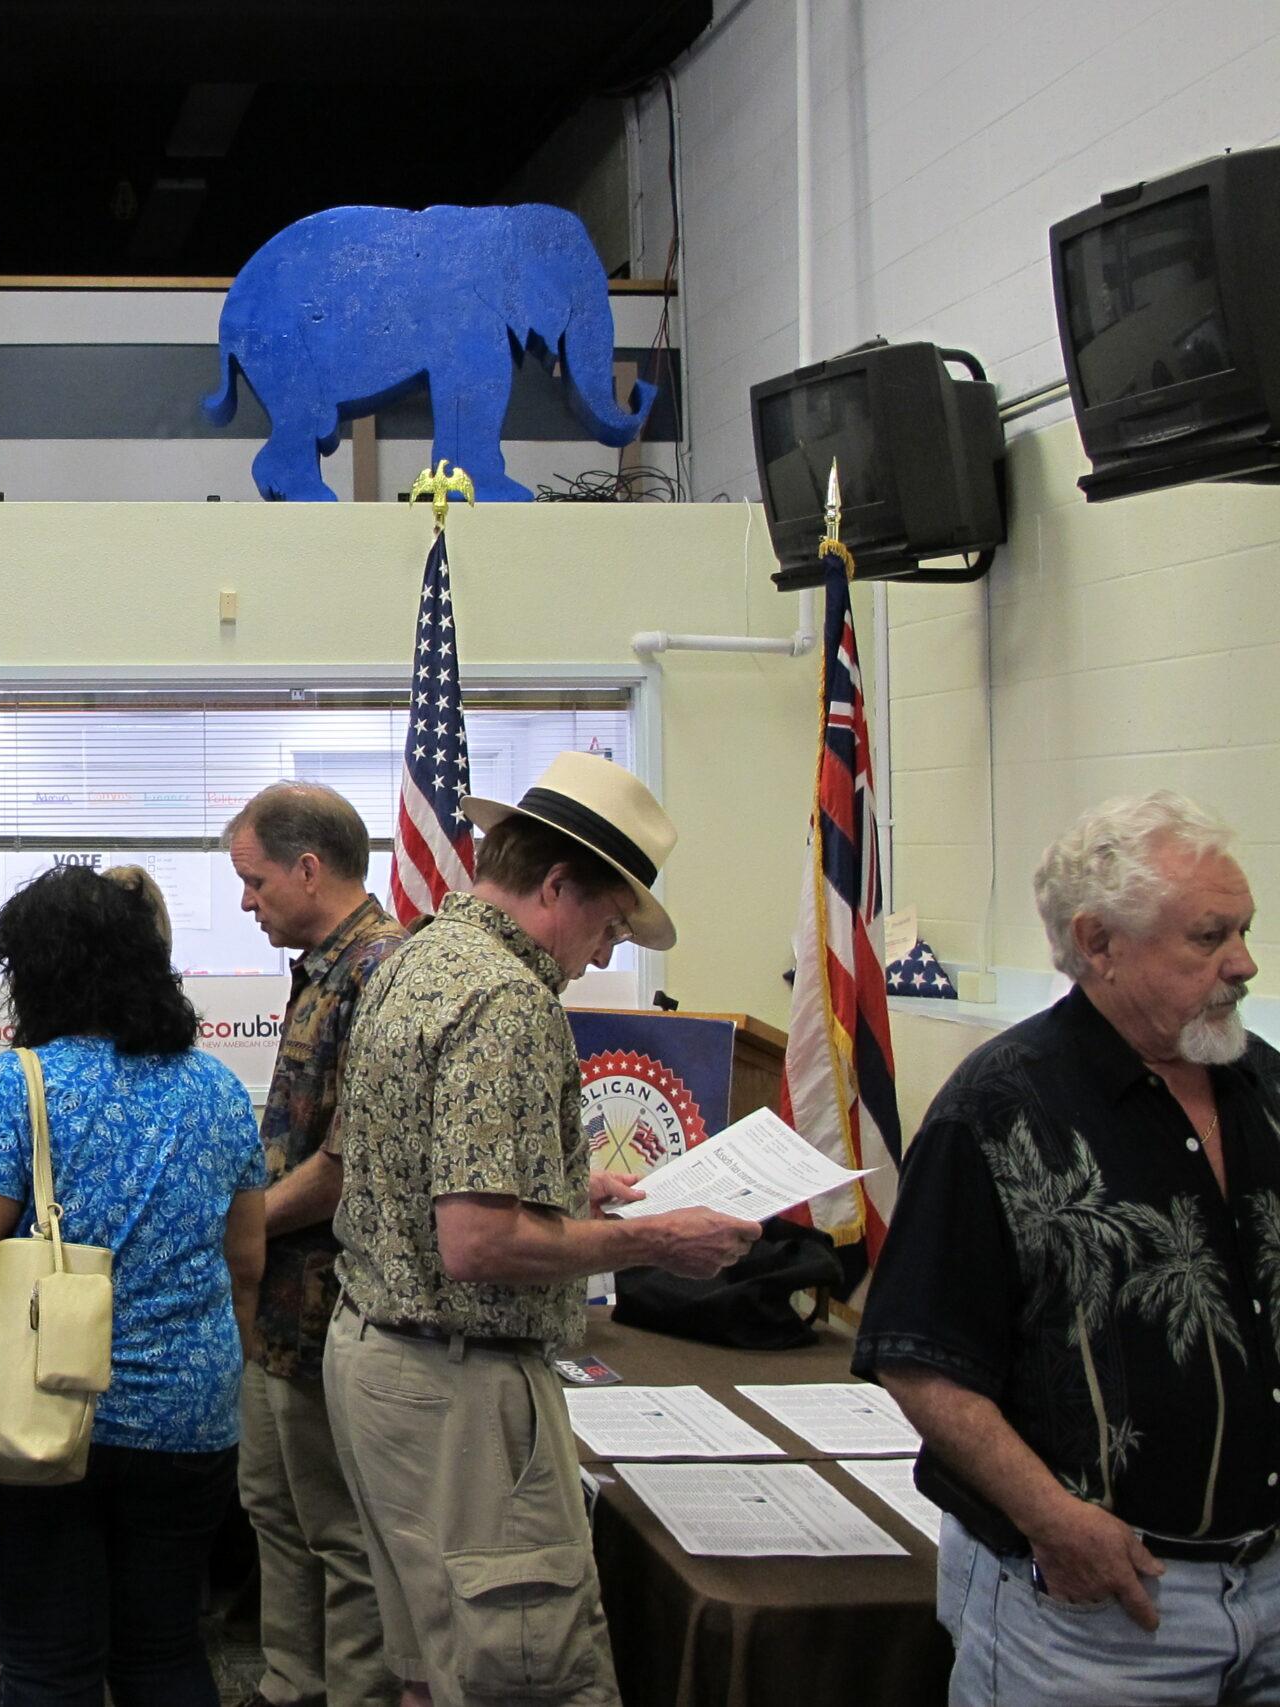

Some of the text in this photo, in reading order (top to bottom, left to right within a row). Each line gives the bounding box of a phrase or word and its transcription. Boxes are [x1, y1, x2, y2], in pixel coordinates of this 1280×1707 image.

[53, 854, 102, 868] VOTE
[200, 1014, 285, 1038] corubi
[222, 1040, 261, 1048] AMERICAN
